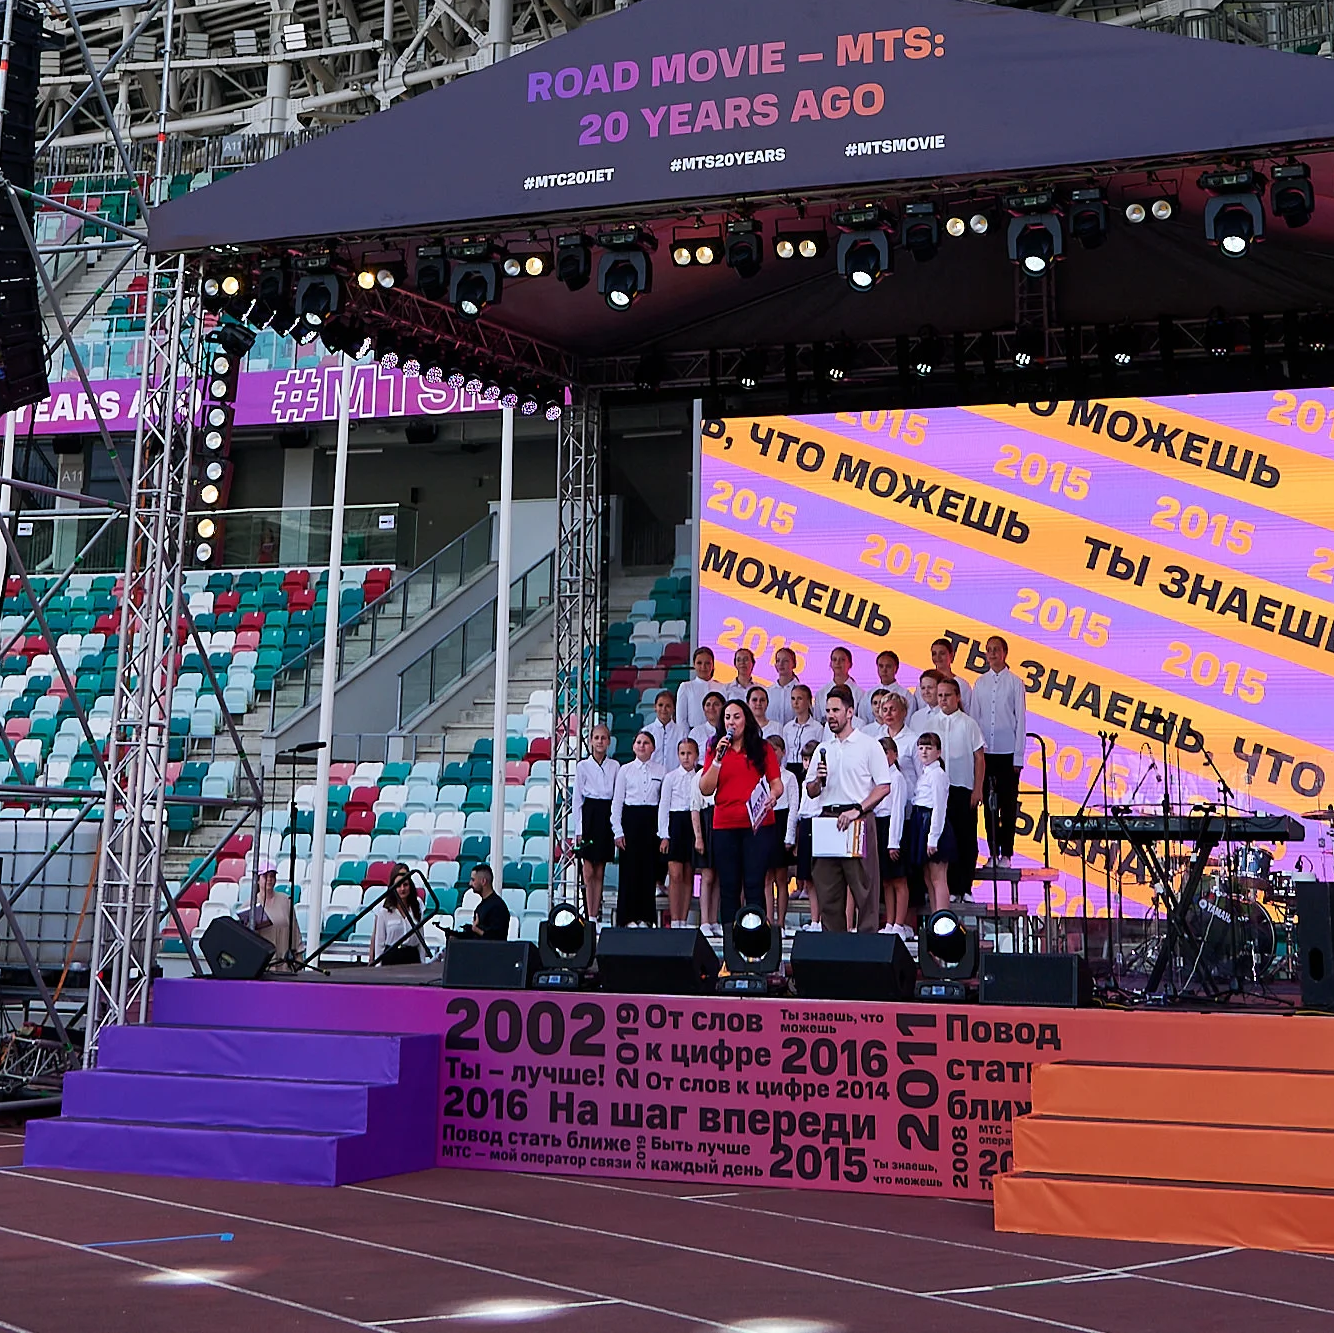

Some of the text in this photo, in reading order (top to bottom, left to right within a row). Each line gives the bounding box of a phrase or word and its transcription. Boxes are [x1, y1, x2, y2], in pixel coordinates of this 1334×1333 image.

[528, 61, 639, 102] ROAD
[652, 41, 786, 87] MOVIE
[837, 27, 945, 66] MTS:
[579, 83, 885, 146] 20 YEARS AGO
[224, 140, 242, 152] A11
[670, 148, 786, 172] #MTS20YEARS
[845, 135, 945, 156] #MTSMOVIE
[524, 168, 615, 190] #МТС20ЛЕТ
[1067, 399, 1281, 489] МОЖЕШЬ
[62, 469, 82, 482] A11
[993, 444, 1092, 500] 2015
[706, 480, 798, 534] 2015
[750, 422, 825, 472] ЧТО
[832, 452, 1030, 544] МОЖЕШЬ
[1084, 536, 1151, 587] ТЫ
[1151, 496, 1256, 556] 2015
[859, 534, 955, 591] 2015
[1011, 588, 1112, 648] 2015
[701, 543, 892, 637] МОЖЕШЬ
[1233, 736, 1325, 798] ЧТО
[1162, 640, 1267, 705] 2015
[1027, 737, 1131, 800] 2015
[445, 997, 605, 1056] 2002
[645, 1004, 763, 1032] От слов
[780, 1009, 884, 1025] Ты знаешь, что
[780, 1023, 837, 1034] можешь
[946, 1013, 1062, 1051] Повод
[616, 1003, 639, 1089] 2019
[645, 1039, 771, 1072] к цифре
[781, 1037, 888, 1078] 2016
[445, 1056, 481, 1079] Ты
[511, 1064, 605, 1089] лучше!
[645, 1072, 890, 1102] От слов к цифре 2014
[896, 1013, 939, 1151] 2011
[443, 1085, 876, 1148] 2016 На шаг впереди
[978, 1125, 1002, 1135] МТС
[442, 1124, 631, 1151] Повод стать ближе
[636, 1135, 646, 1170] 2019
[651, 1136, 751, 1156] Быть лучше
[978, 1136, 1013, 1147] опера
[442, 1144, 471, 1158] МТС
[490, 1148, 517, 1162] мой
[520, 1152, 586, 1168] оператор
[590, 1156, 632, 1169] связи
[650, 1158, 763, 1177] каждый день
[769, 1143, 868, 1183] 2015
[873, 1159, 938, 1173] Ты знаешь,
[952, 1126, 968, 1188] 2008
[873, 1176, 943, 1187] что можешь
